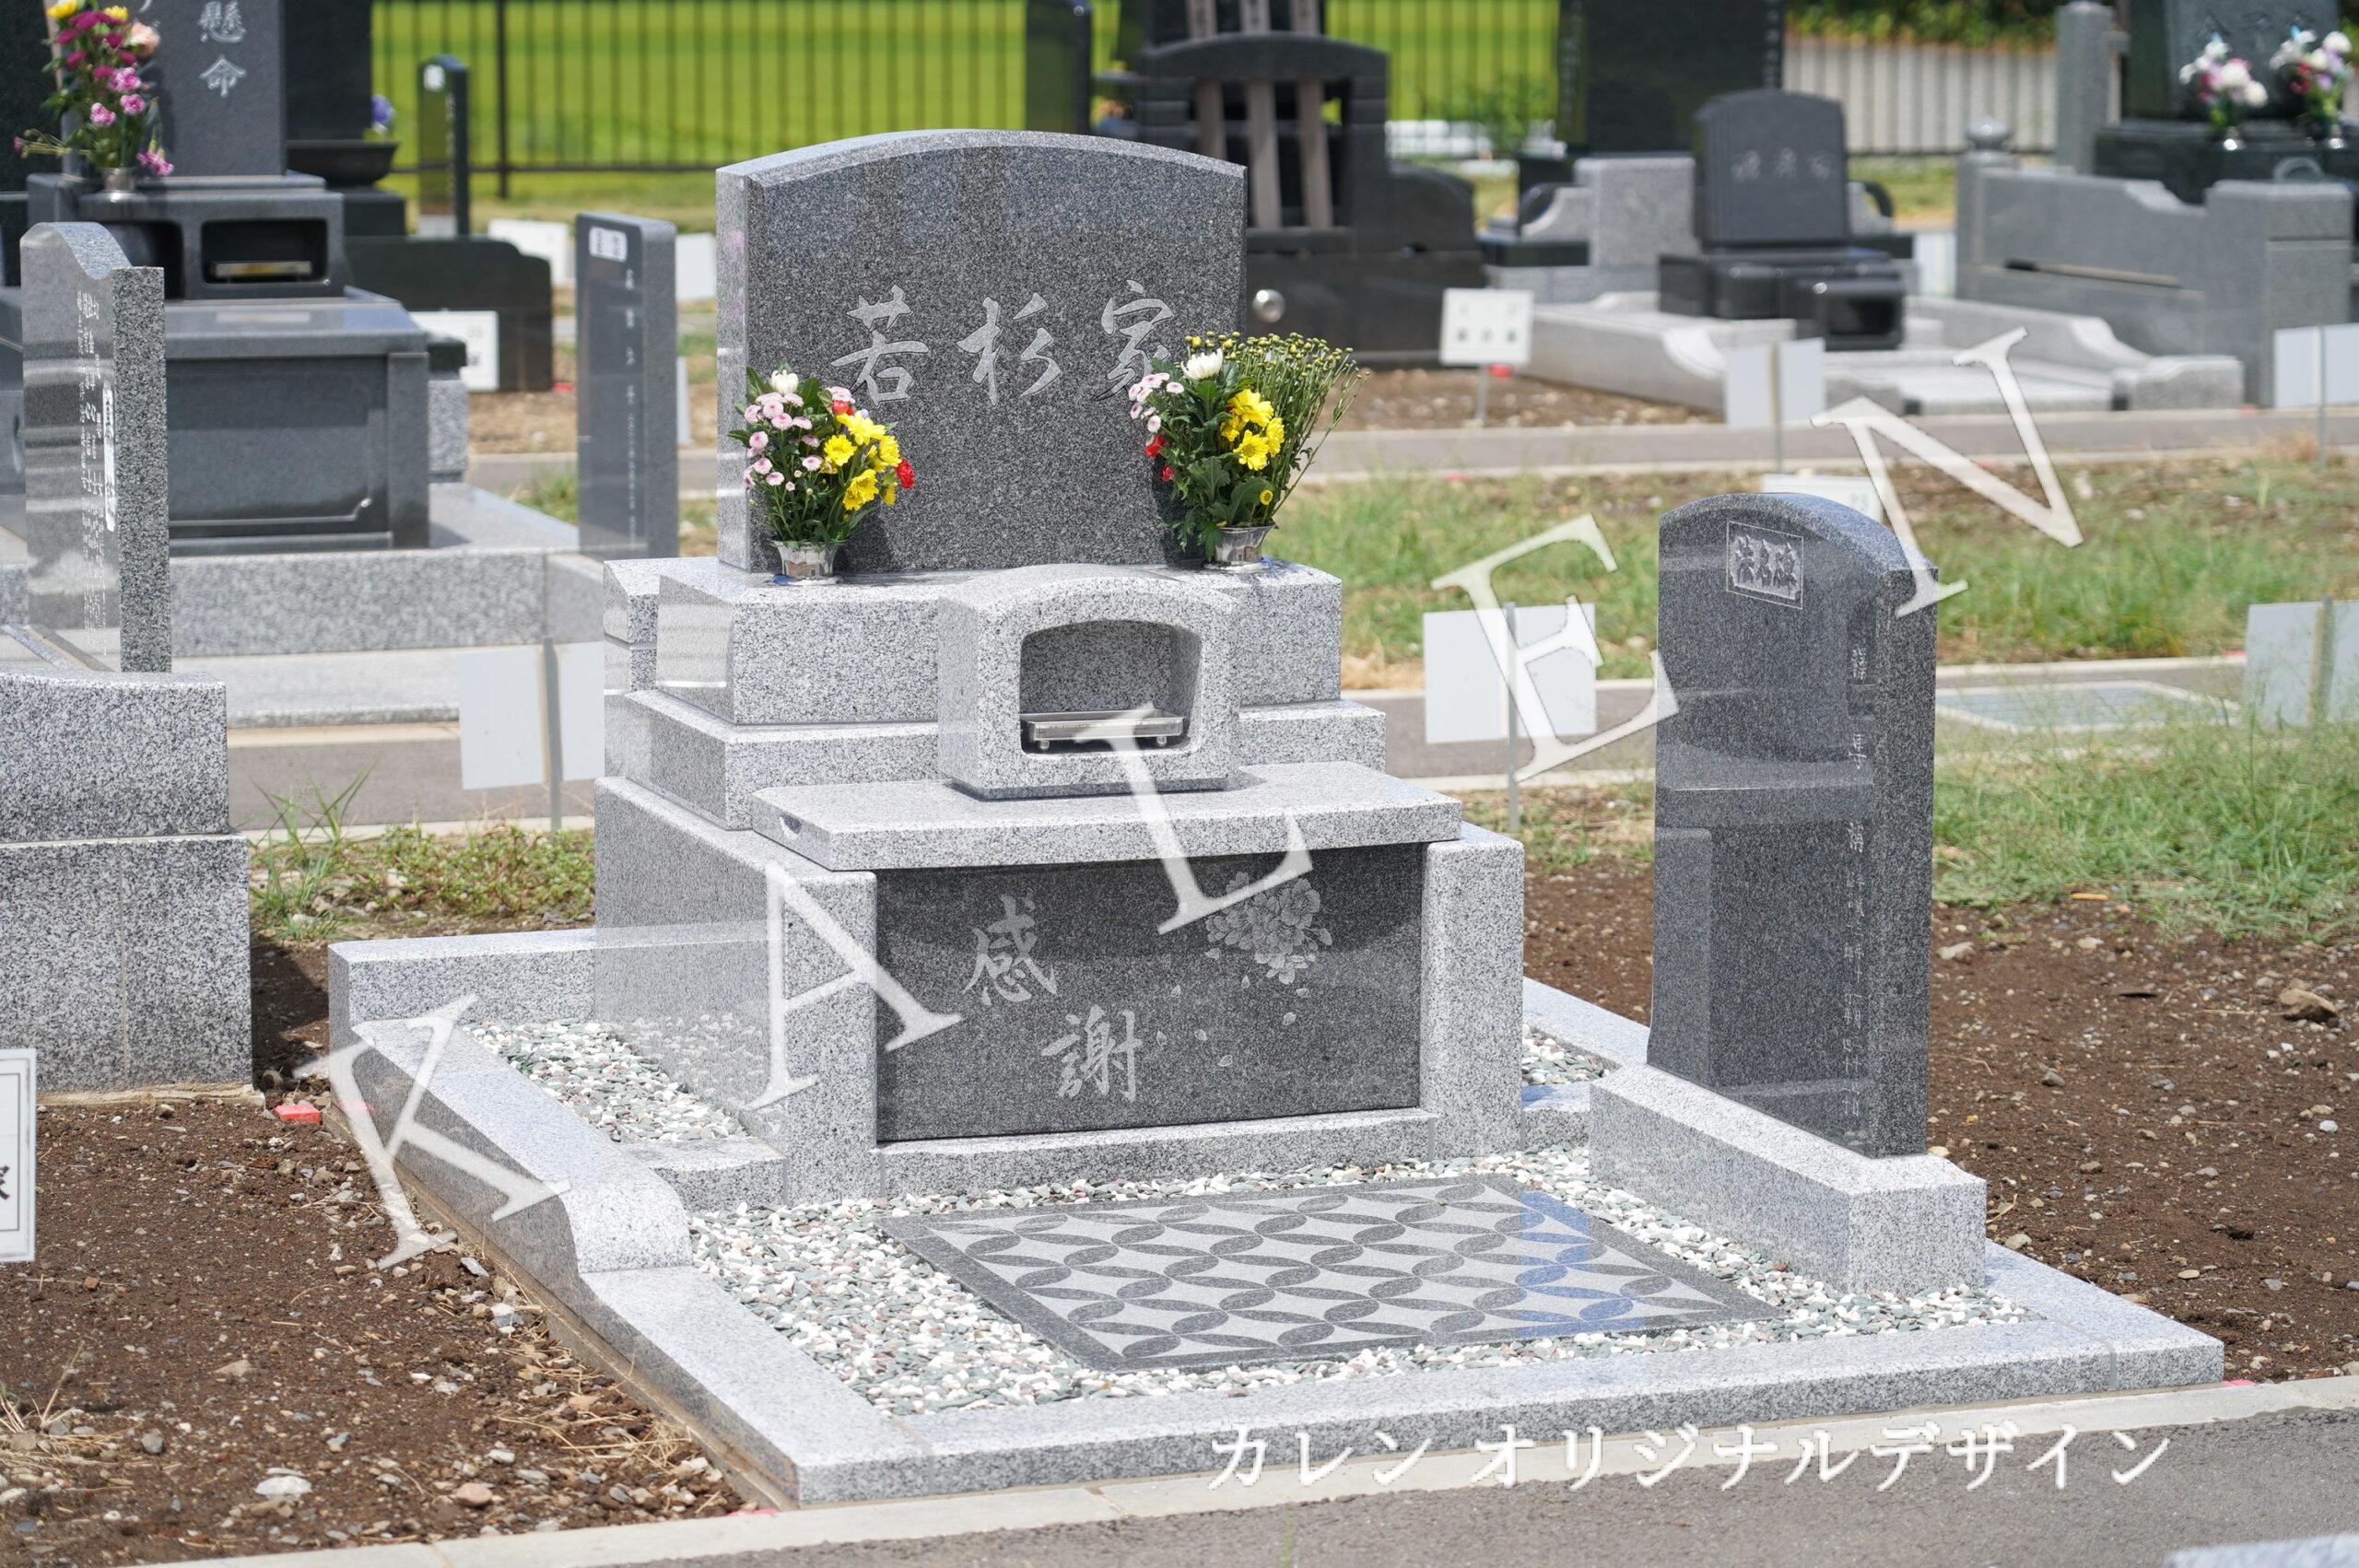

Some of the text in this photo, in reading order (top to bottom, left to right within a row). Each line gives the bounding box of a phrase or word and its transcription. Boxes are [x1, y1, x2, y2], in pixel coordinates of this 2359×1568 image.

[830, 279, 1175, 408] 若杉家
[962, 894, 1144, 1103] 感謝
